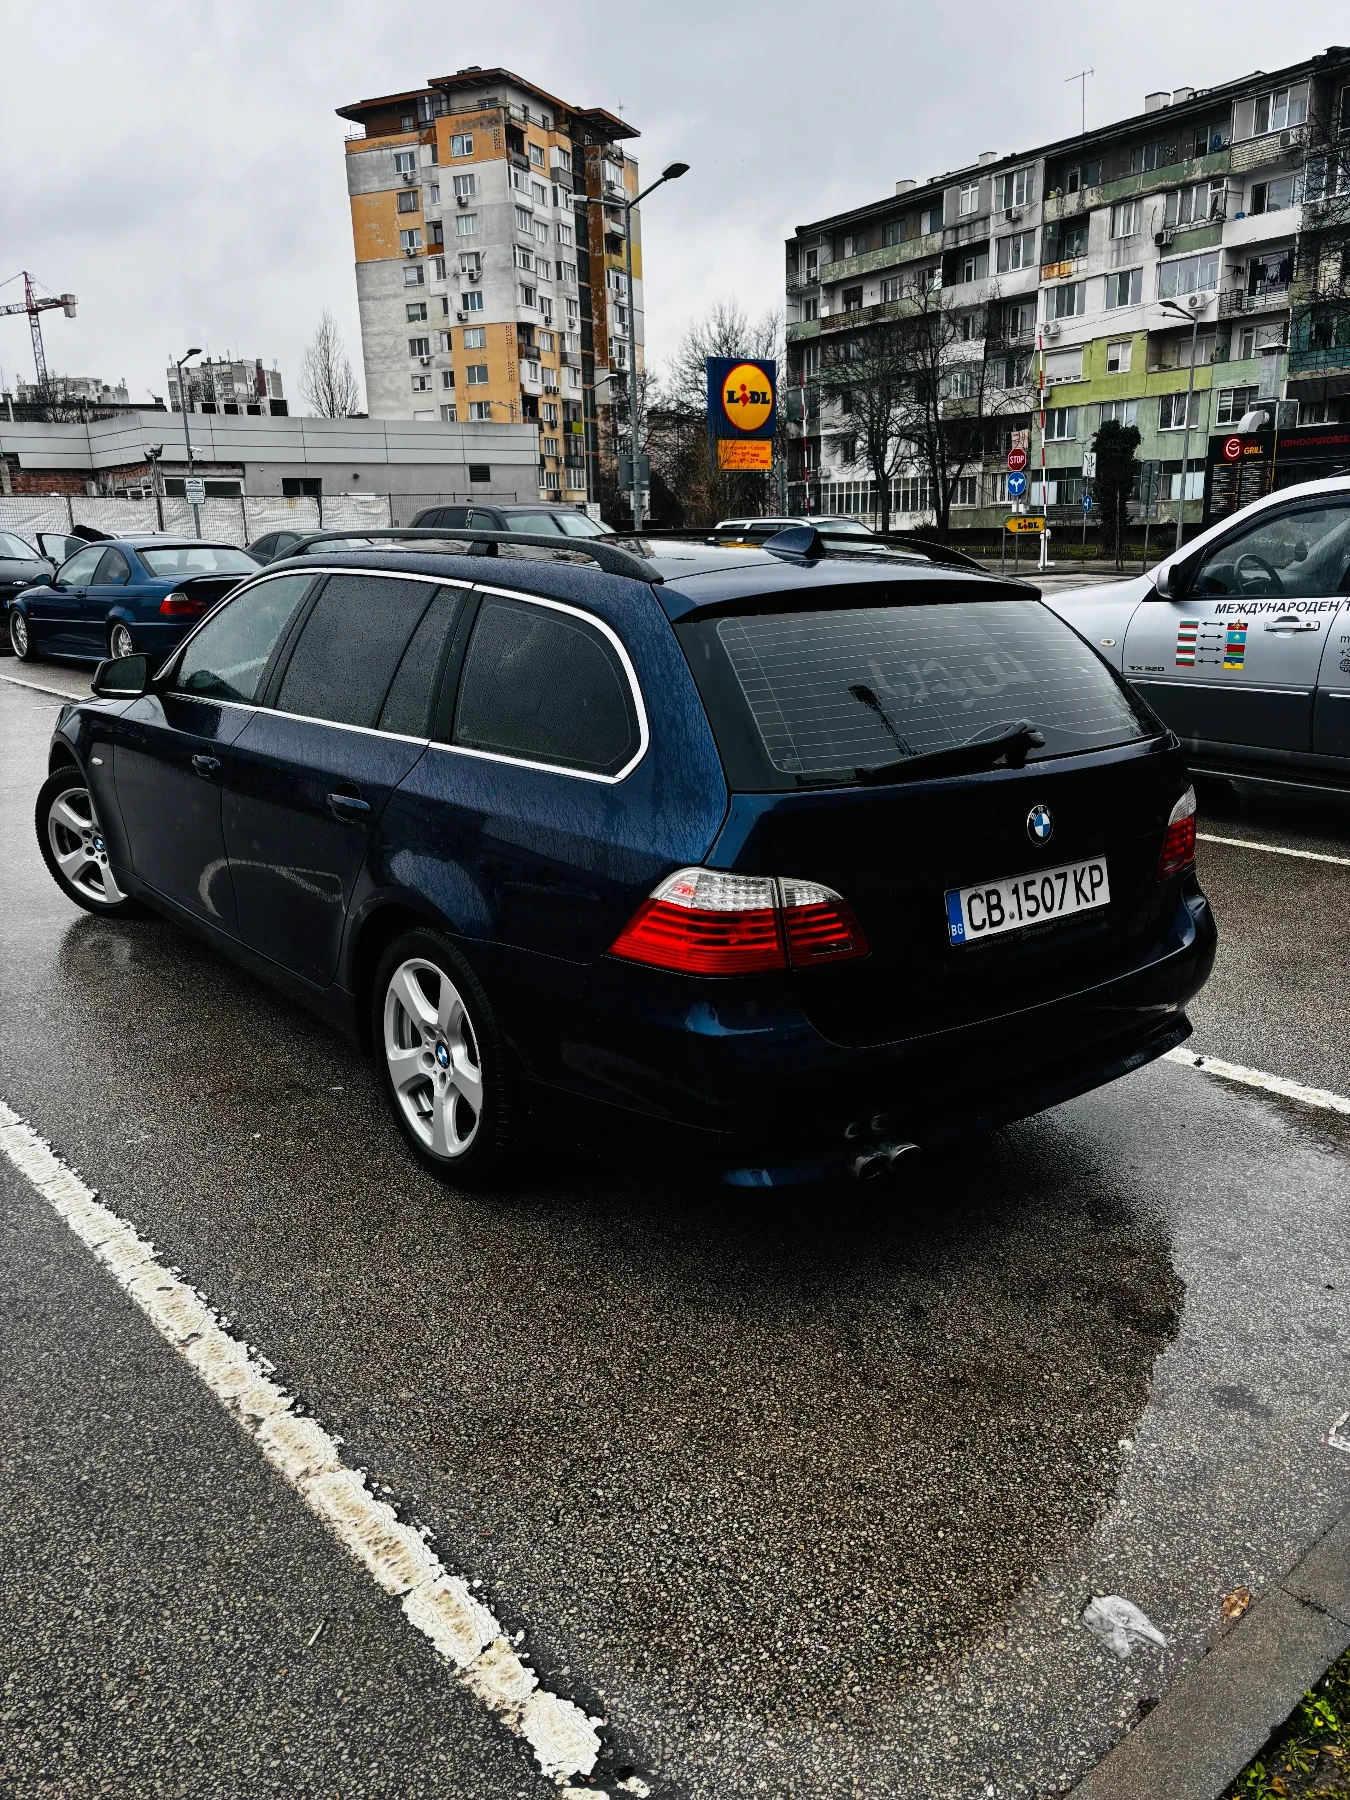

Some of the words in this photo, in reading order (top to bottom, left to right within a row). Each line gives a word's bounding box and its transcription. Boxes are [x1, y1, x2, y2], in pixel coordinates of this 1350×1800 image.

[1243, 446, 1264, 455] GRILL
[1010, 455, 1025, 465] STOP
[1215, 601, 1340, 615] МЕЖДУНАРОДЕН
[1012, 871, 1068, 921] 1507
[1073, 864, 1104, 906] KP
[951, 923, 964, 936] BG
